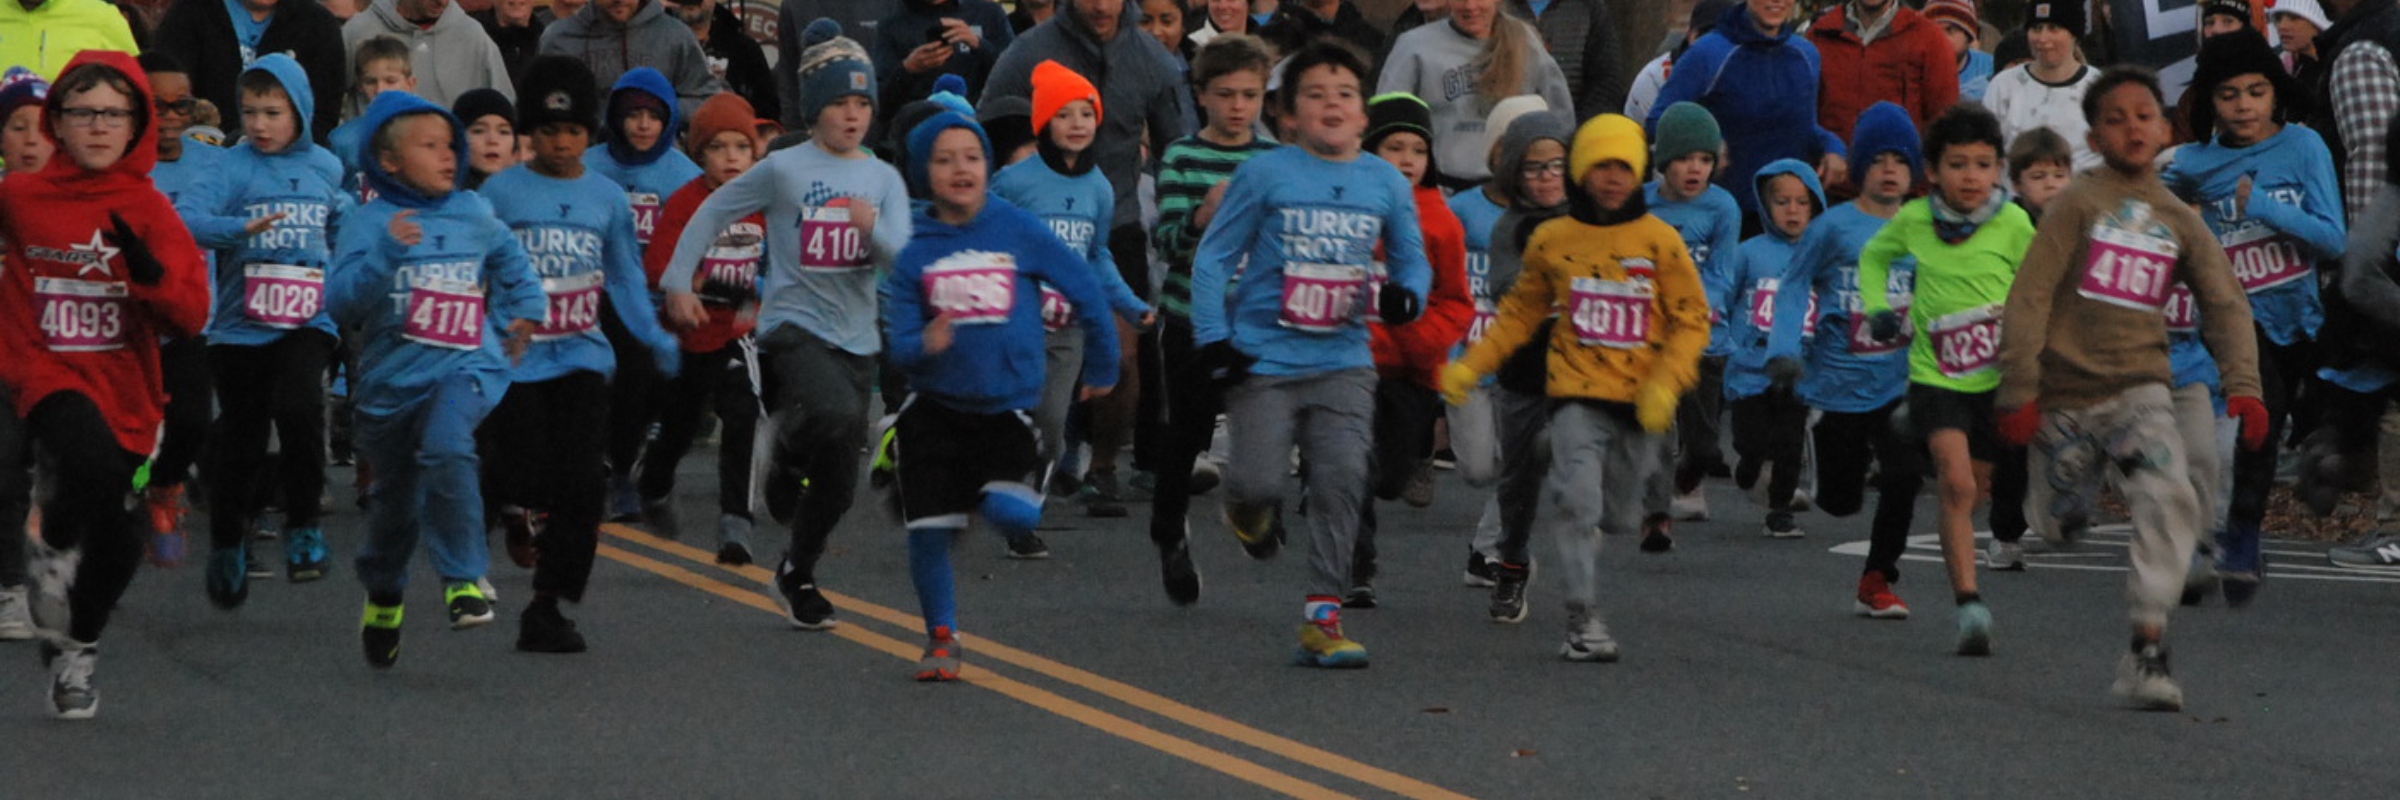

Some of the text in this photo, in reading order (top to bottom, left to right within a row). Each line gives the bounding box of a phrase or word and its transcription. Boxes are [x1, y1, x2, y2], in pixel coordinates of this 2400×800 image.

[2091, 249, 2168, 299] 4161
[40, 299, 121, 338] 4093
[249, 282, 319, 318] 4028
[411, 296, 478, 337] 4174
[1572, 298, 1645, 337] 4011
